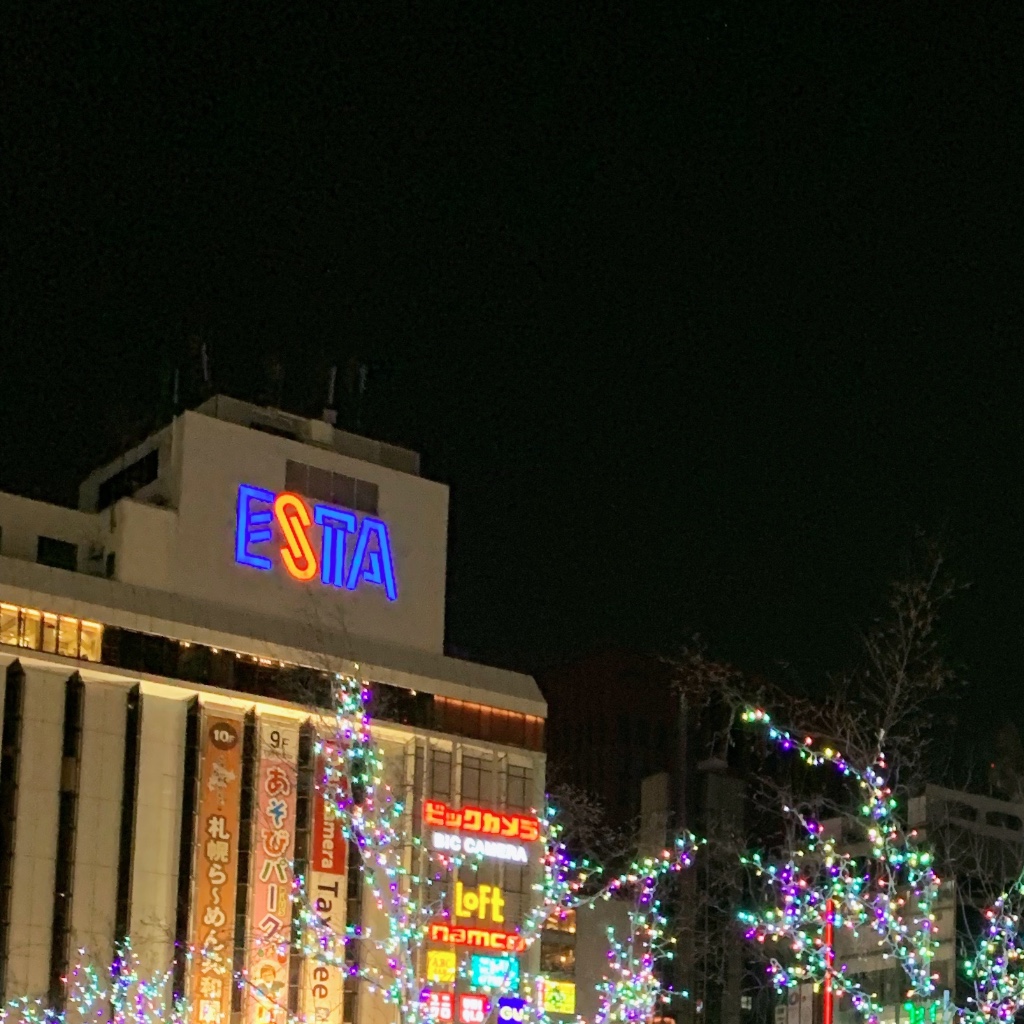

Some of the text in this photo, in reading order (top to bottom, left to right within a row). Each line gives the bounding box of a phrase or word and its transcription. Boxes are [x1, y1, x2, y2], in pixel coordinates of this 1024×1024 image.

[235, 483, 399, 601] ESTA
[270, 731, 290, 749] 9F
[424, 801, 540, 842] ビックカメラ
[258, 766, 291, 941] あそびパーク
[432, 831, 529, 864] BIC CAMERA
[431, 924, 526, 951] namco
[500, 1006, 524, 1022] GU
